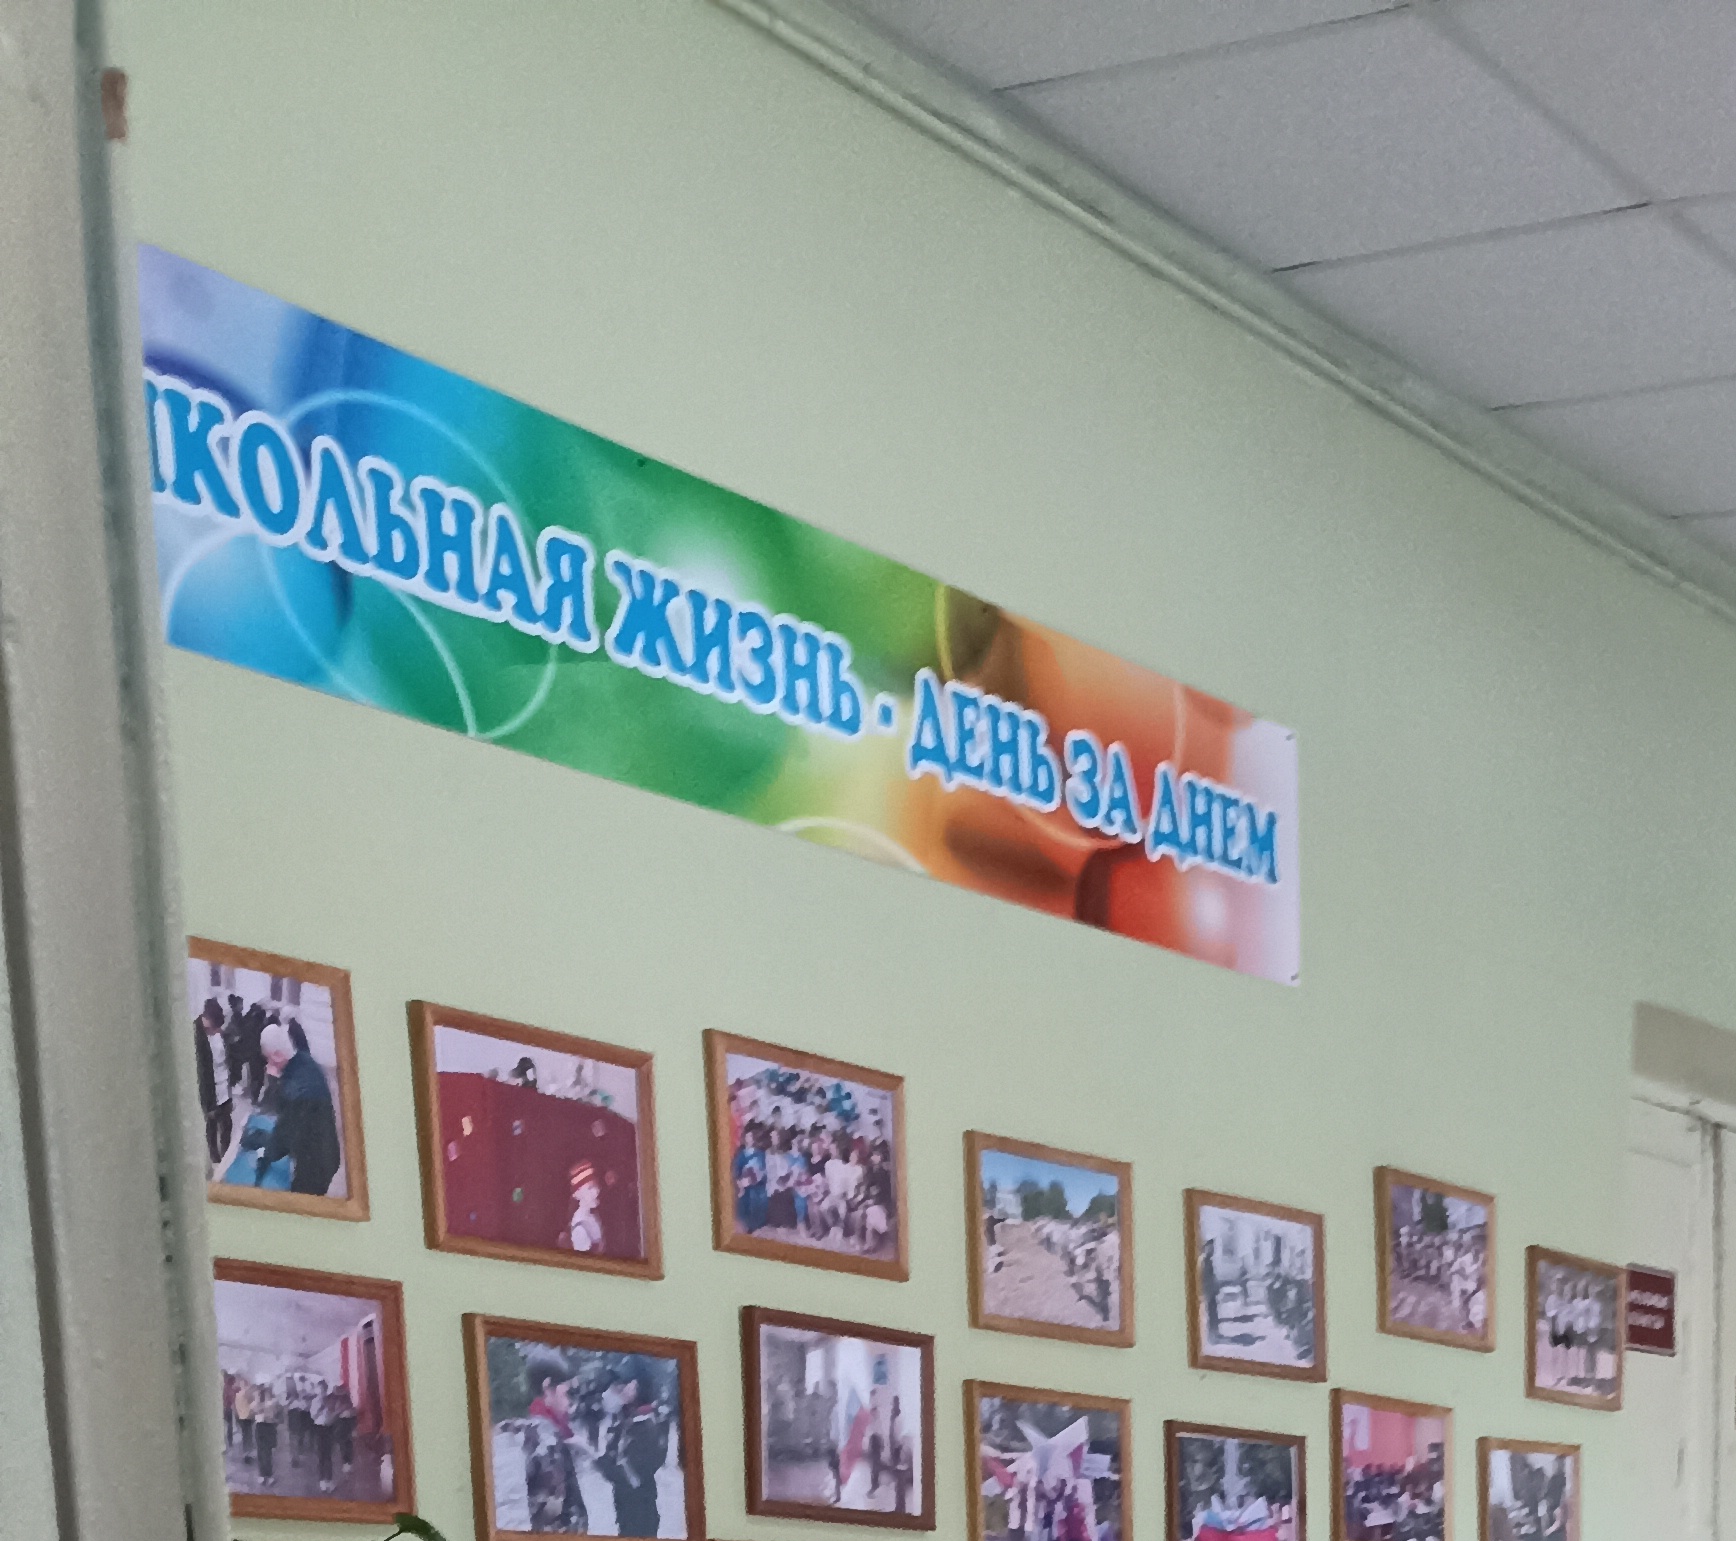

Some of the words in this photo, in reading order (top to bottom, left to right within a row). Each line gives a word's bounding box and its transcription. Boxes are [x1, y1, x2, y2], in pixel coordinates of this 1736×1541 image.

[612, 560, 861, 737] ЖИЗНЬ
[910, 676, 1057, 807] ДЕНЬ
[1067, 737, 1139, 834] ЗА
[1150, 766, 1279, 885] ДНЕМ
